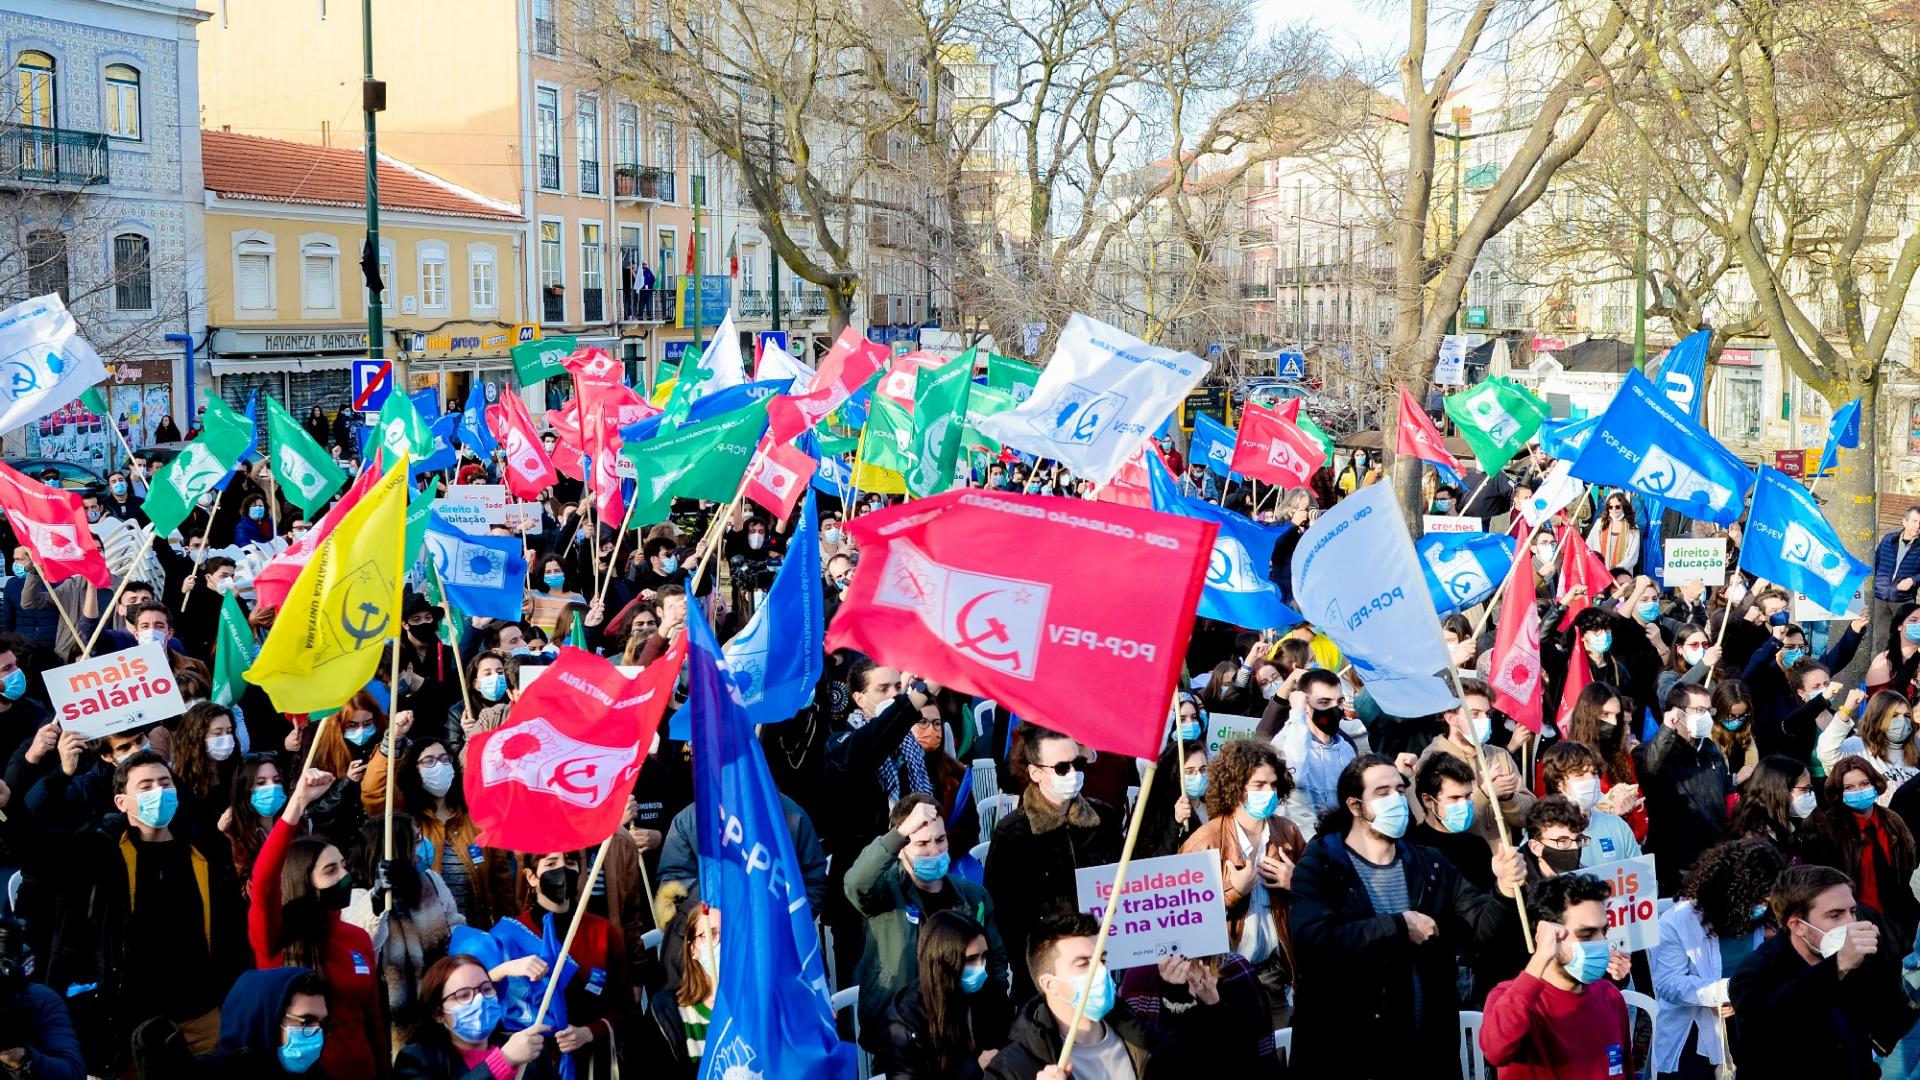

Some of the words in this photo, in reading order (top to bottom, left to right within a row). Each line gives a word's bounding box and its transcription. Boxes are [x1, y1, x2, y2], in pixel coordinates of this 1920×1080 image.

[265, 335, 316, 350] HAVANEZA
[322, 333, 367, 349] BANDEIRA
[521, 328, 533, 340] M
[361, 364, 384, 407] P
[1645, 397, 1676, 425] COLIGAÇÃO
[1600, 430, 1641, 463] PCP-PEV
[440, 504, 471, 514] direito
[474, 505, 480, 514] à
[444, 514, 486, 526] abitação
[1668, 558, 1723, 571] educação
[1672, 547, 1710, 558] direito
[1713, 547, 1719, 557] à
[304, 601, 321, 650] UNITÁRIA
[69, 655, 149, 694] mais
[62, 676, 172, 721] salário
[1095, 868, 1205, 900] igualdade
[1604, 867, 1639, 899] ais
[1122, 888, 1215, 914] trabalho
[1605, 895, 1654, 929] ário
[1107, 923, 1119, 937] e
[1124, 918, 1152, 935] na
[1156, 909, 1203, 929] vida
